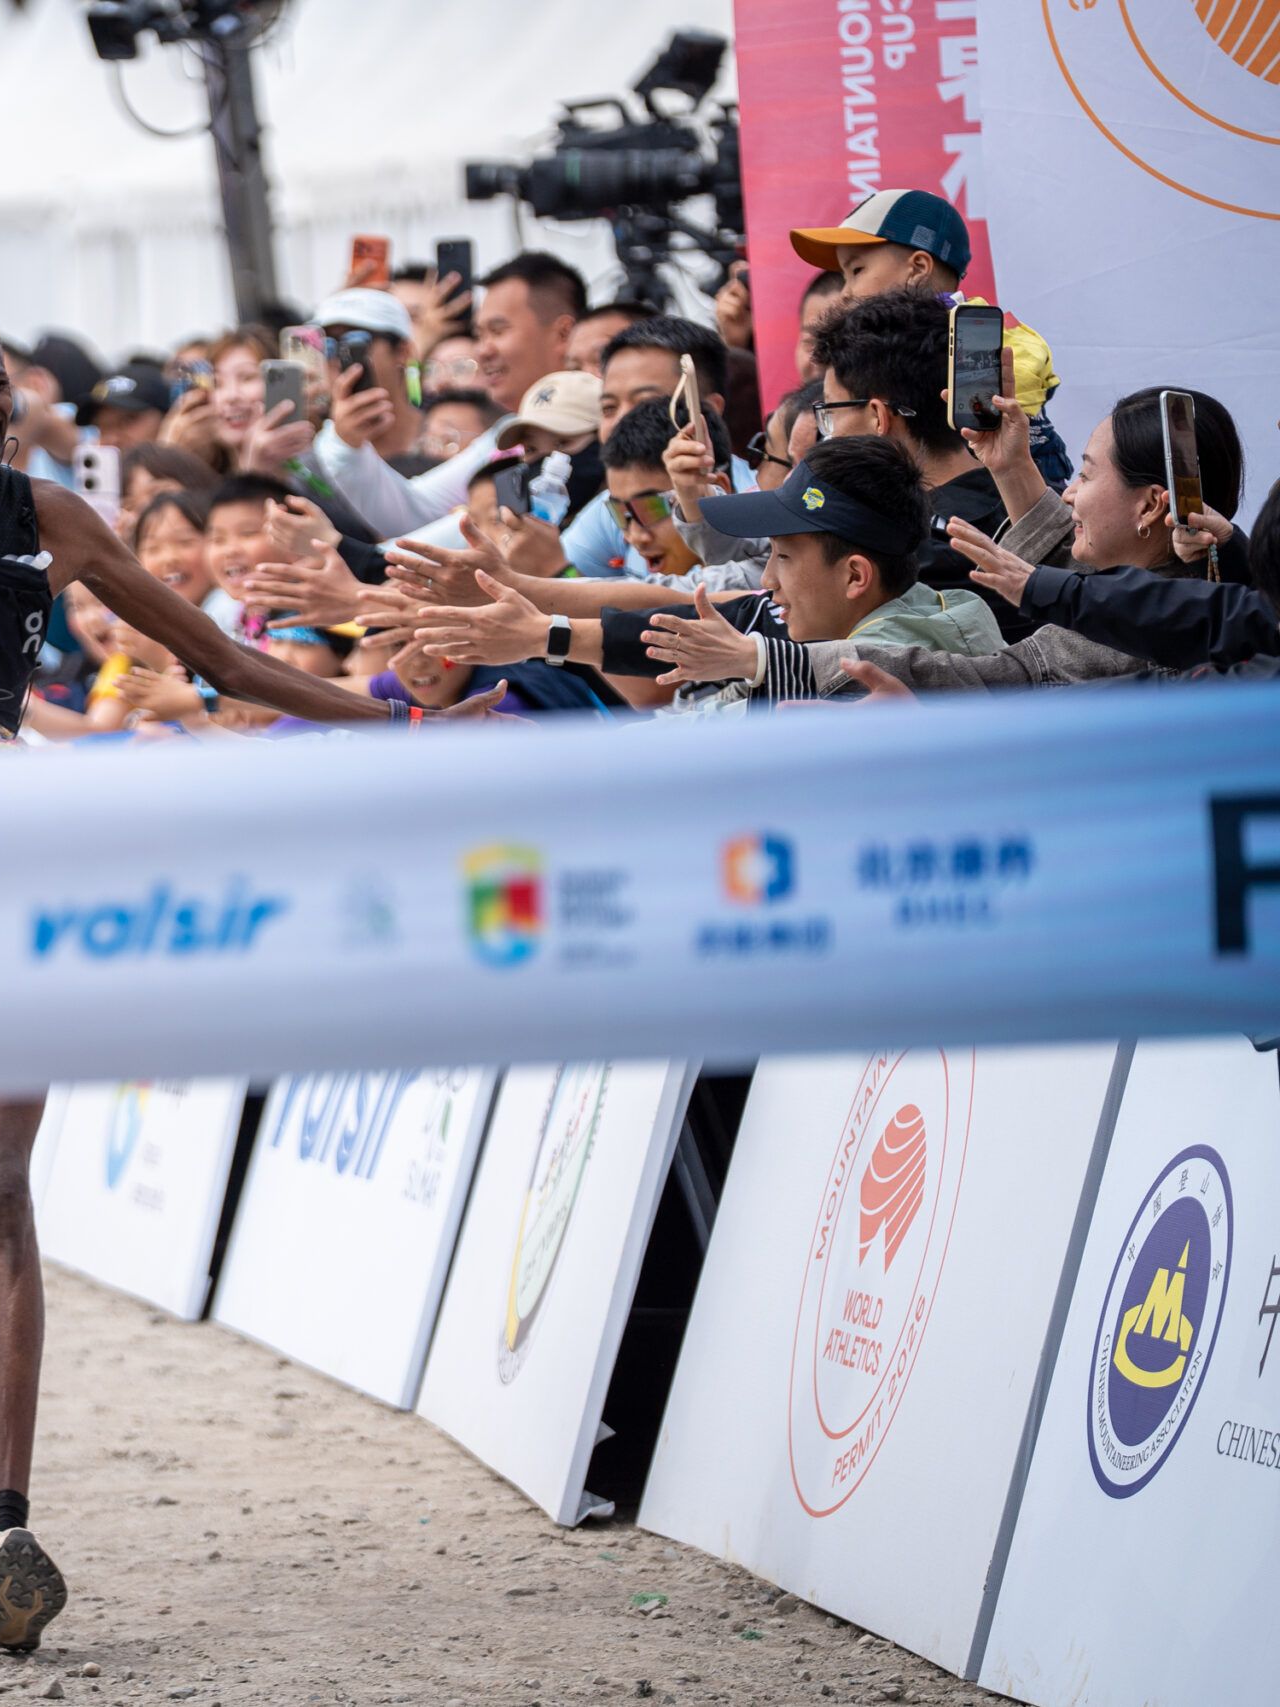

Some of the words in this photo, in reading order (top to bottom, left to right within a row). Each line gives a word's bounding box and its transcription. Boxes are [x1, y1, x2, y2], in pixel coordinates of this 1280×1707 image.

[843, 1289, 883, 1329] WORLD
[823, 1328, 882, 1376] ATHLETICS
[832, 1400, 884, 1488] PERMIT
[888, 1295, 925, 1405] 2026
[1097, 1334, 1111, 1412] CHINESE
[1149, 1350, 1203, 1456] ASSOCIATION
